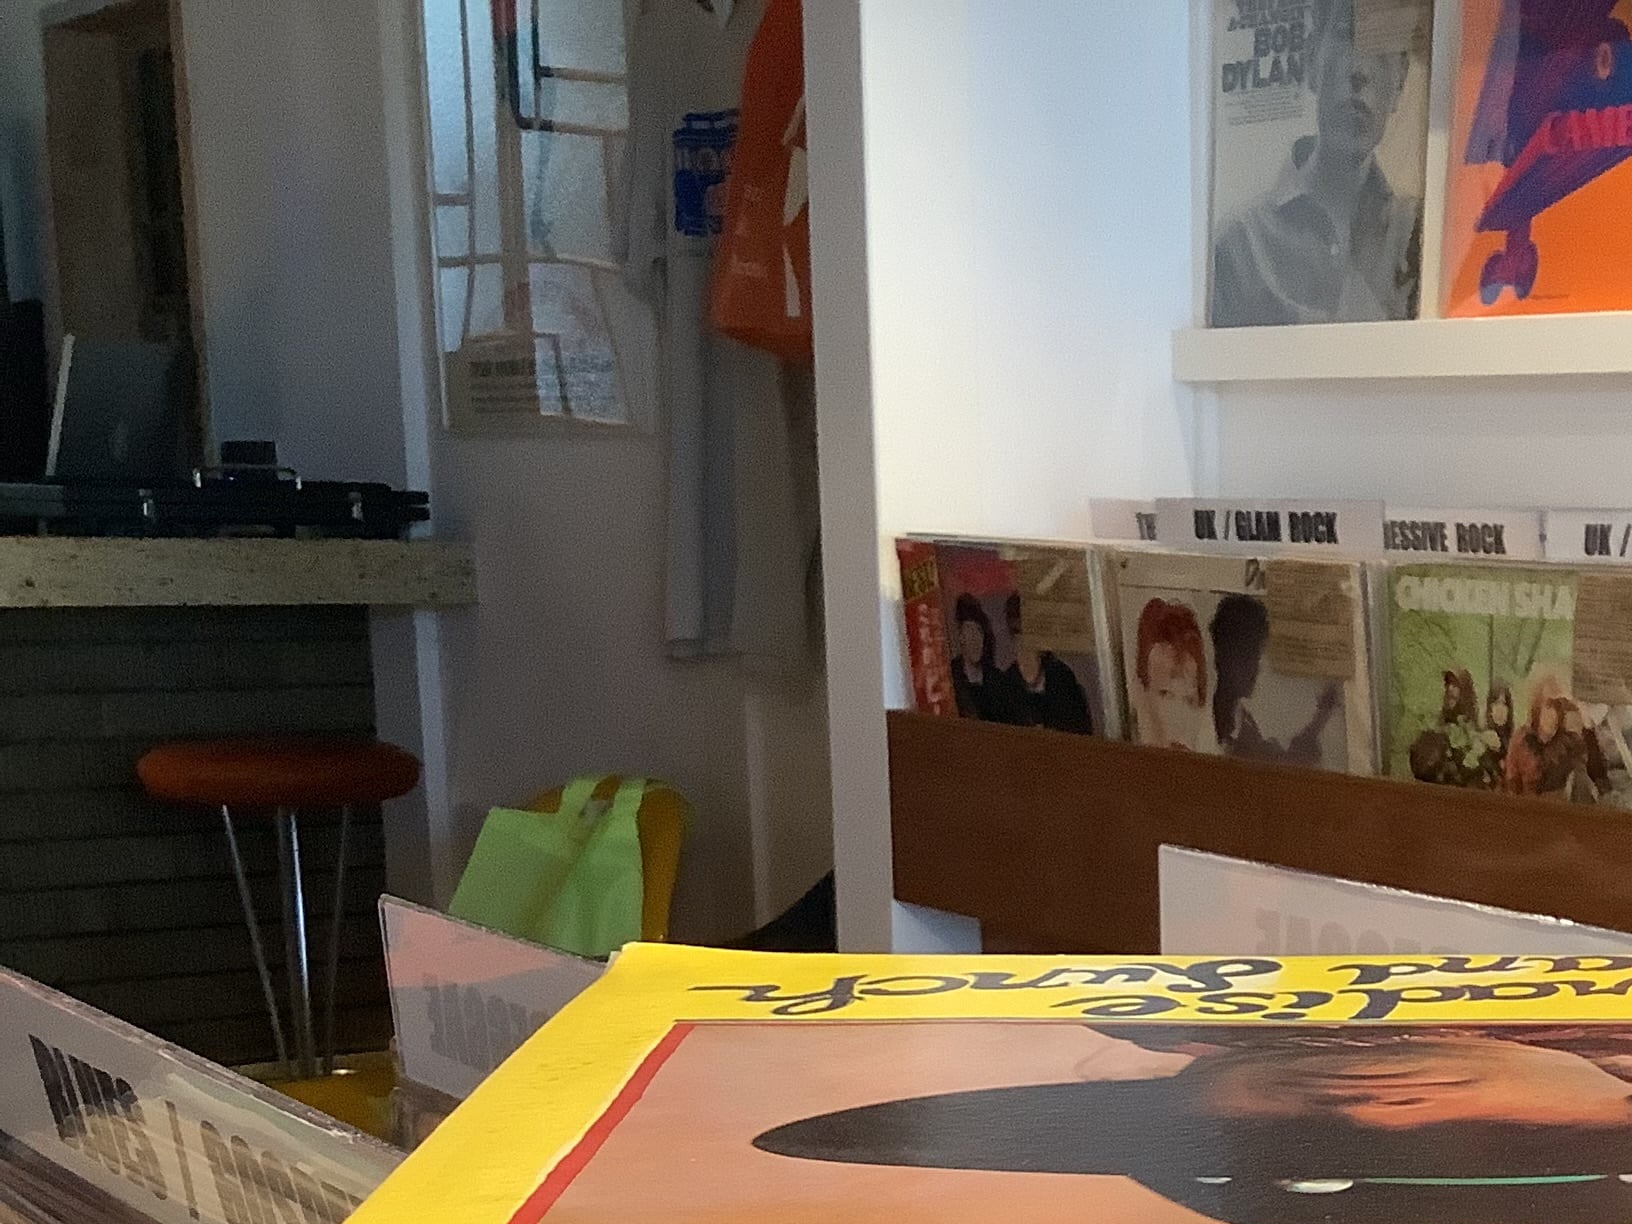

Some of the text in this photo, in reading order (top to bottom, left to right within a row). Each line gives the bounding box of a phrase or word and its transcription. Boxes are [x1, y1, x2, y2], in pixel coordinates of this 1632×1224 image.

[1254, 24, 1305, 57] BOB
[1222, 51, 1305, 93] DYLAN
[1194, 510, 1338, 544] UK / GLAM ROCK
[1456, 522, 1506, 555] ROCK
[1584, 524, 1612, 556] UK
[1619, 524, 1632, 556] /
[690, 957, 1284, 1016] Lunch
